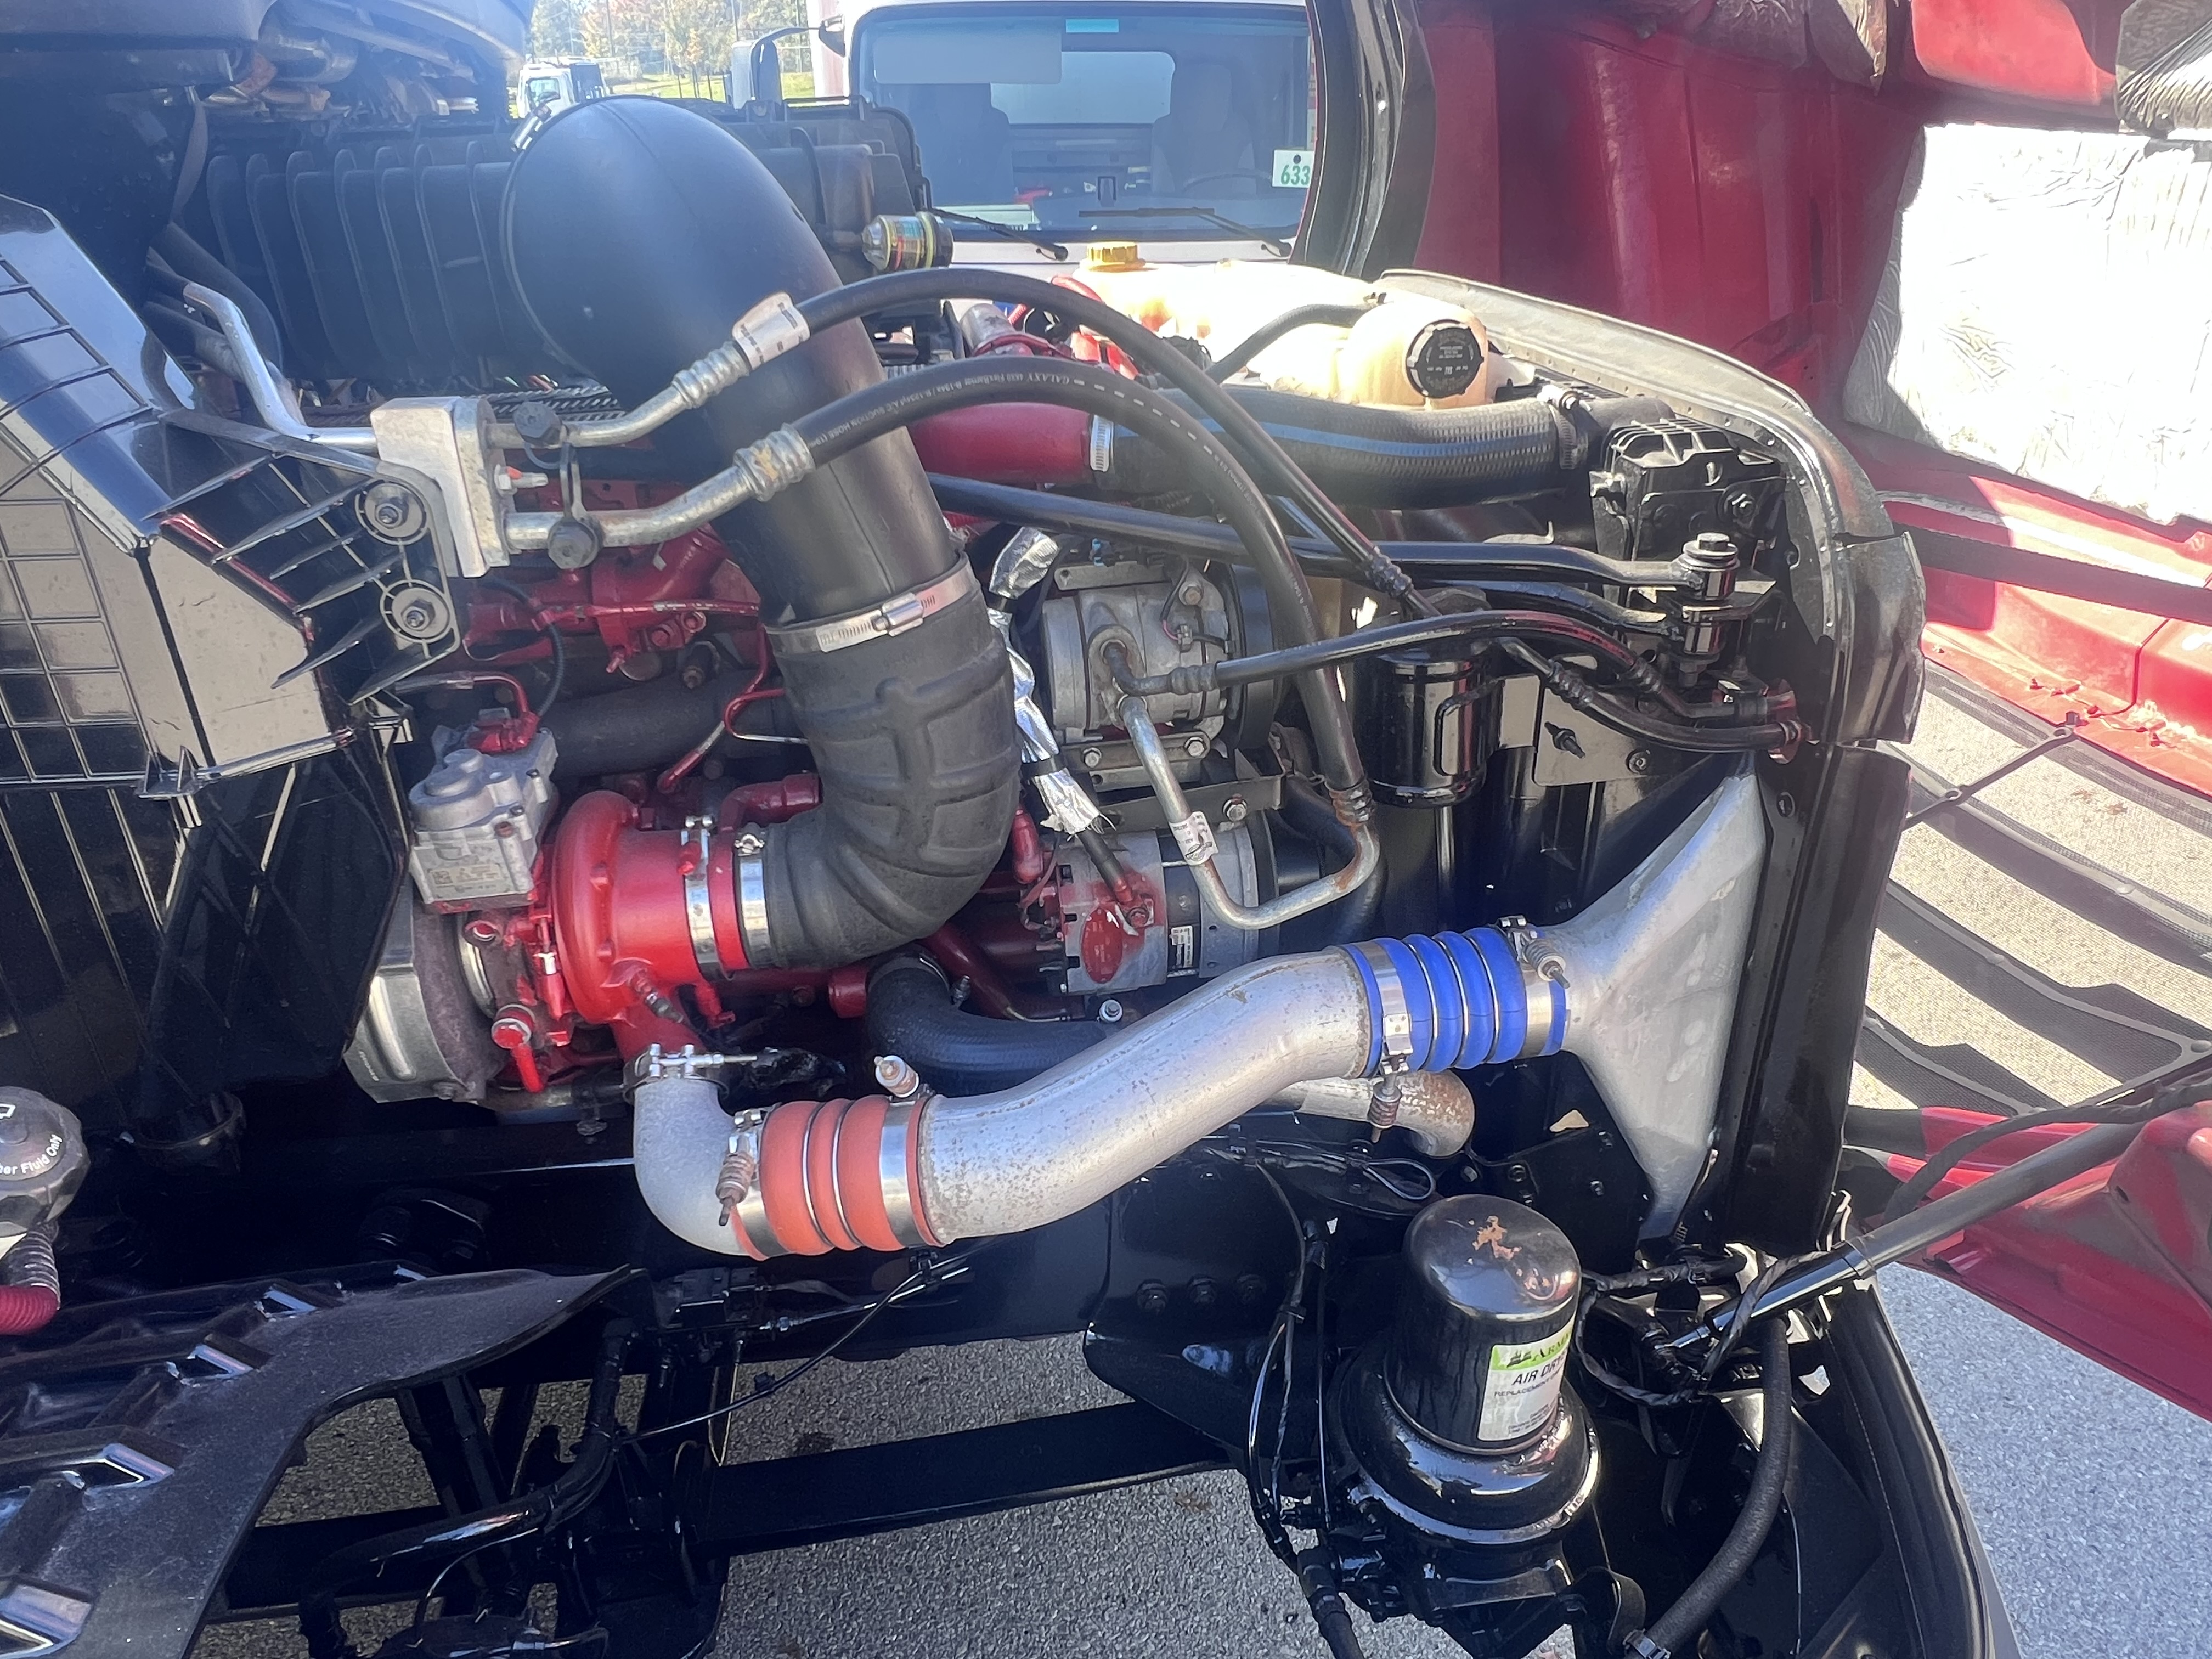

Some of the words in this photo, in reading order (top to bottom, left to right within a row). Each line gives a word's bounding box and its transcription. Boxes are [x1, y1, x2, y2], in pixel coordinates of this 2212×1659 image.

[1280, 165, 1311, 185] 633
[1028, 372, 1070, 385] GALAXY
[828, 422, 851, 438] HOSE
[20, 1154, 50, 1174] Fluid
[46, 1134, 63, 1157] Only
[1511, 1370, 1538, 1385] AIR
